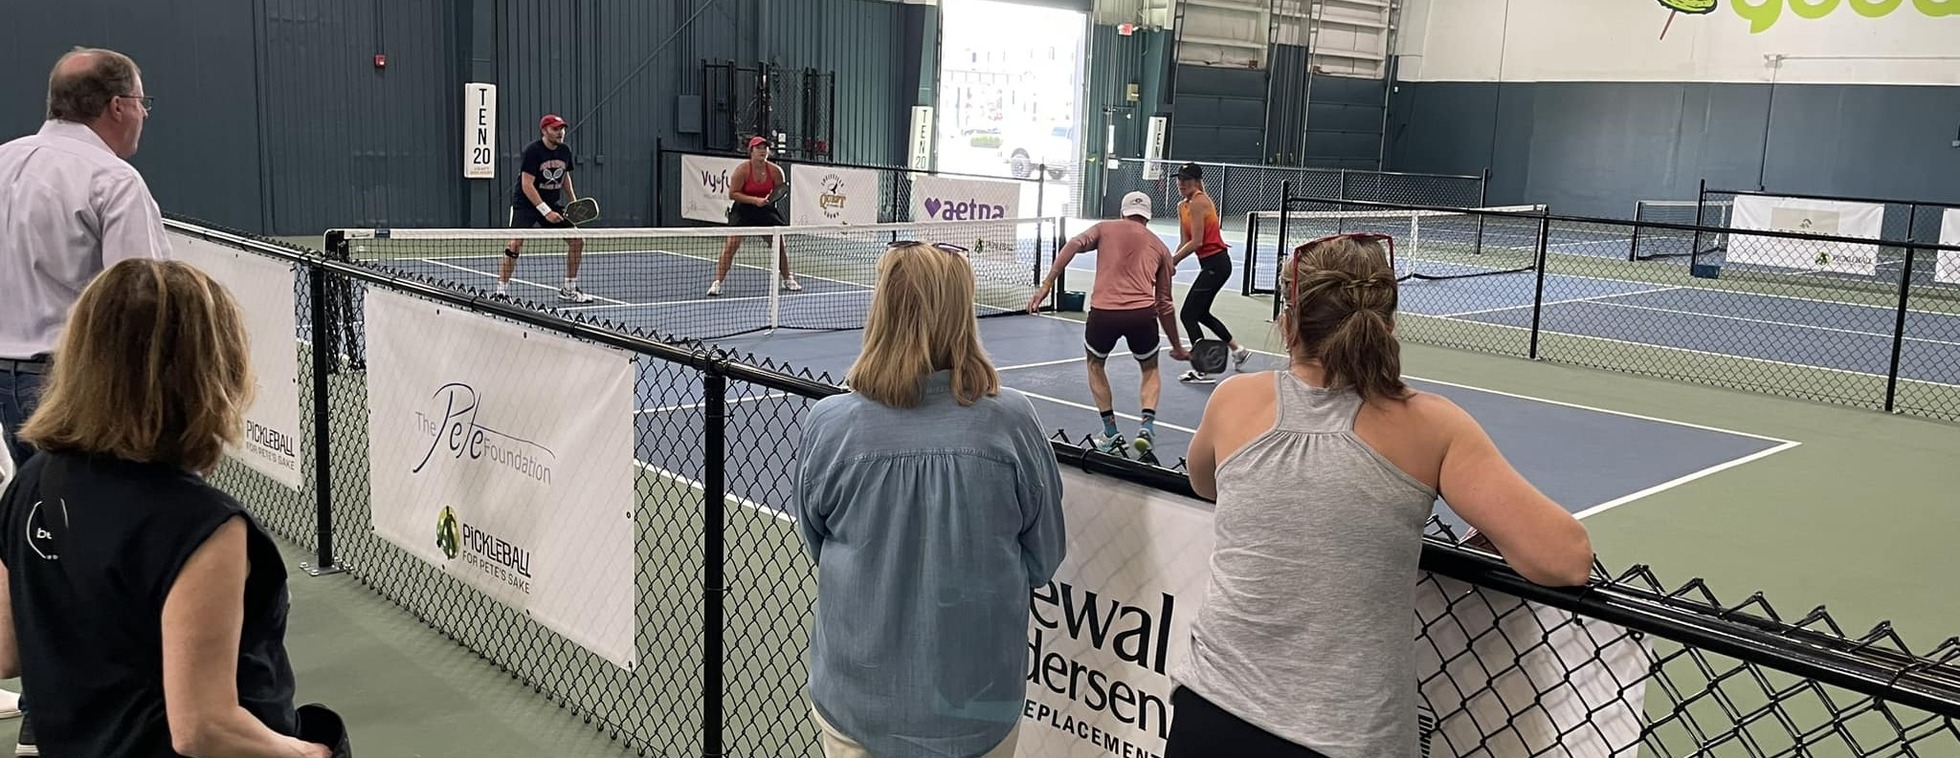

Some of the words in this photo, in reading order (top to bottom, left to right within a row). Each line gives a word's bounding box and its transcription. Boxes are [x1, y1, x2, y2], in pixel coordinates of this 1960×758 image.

[478, 88, 487, 145] TEN
[919, 109, 927, 154] TEN
[473, 147, 491, 165] 20
[915, 155, 927, 169] 20
[942, 198, 1005, 221] aetna
[413, 383, 484, 473] Pete
[415, 411, 437, 437] The
[483, 438, 551, 485] Foundation
[463, 550, 478, 567] FOR
[480, 559, 506, 581] PETE'S
[508, 573, 530, 594] SAKE
[1029, 580, 1174, 676] ewal
[1026, 627, 1169, 741] dersen
[1023, 699, 1163, 758] EPLACEMEN
